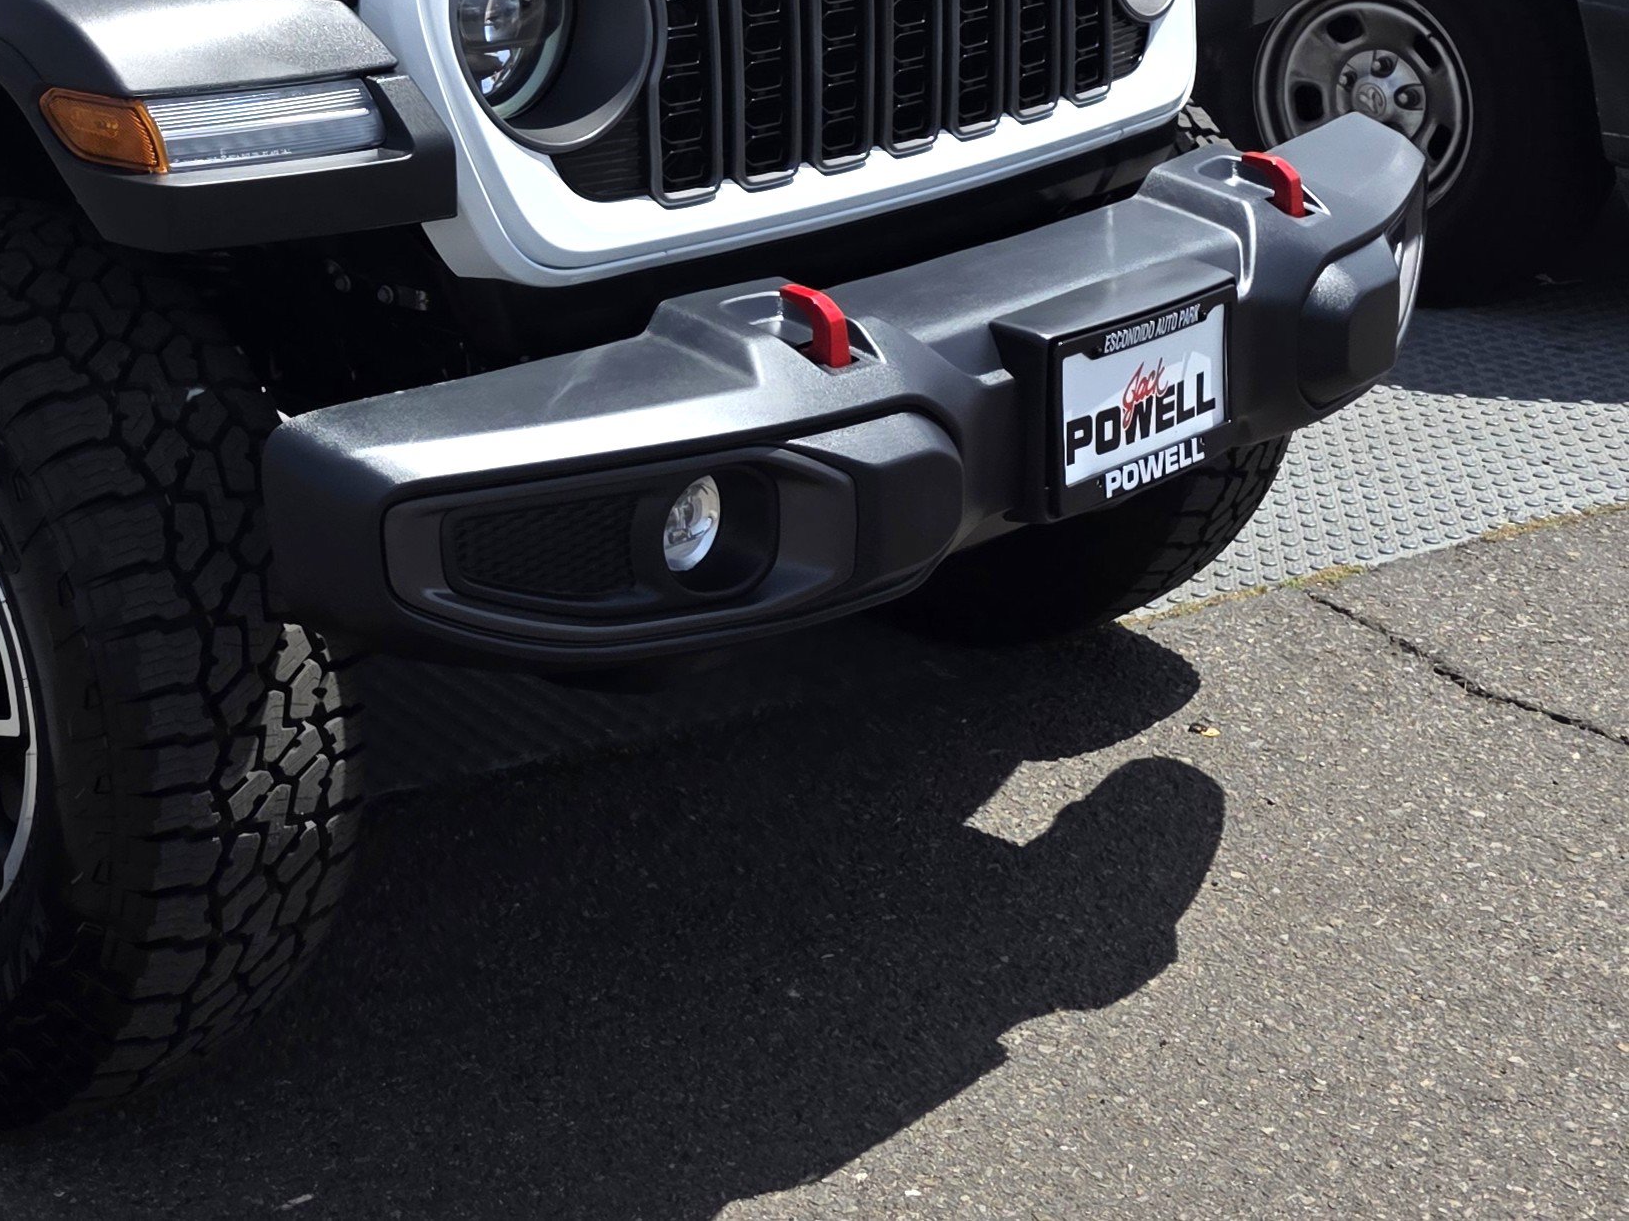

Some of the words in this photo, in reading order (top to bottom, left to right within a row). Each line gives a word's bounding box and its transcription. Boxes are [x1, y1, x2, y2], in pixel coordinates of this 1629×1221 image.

[1104, 320, 1155, 353] ESCONDIDO
[1155, 312, 1178, 337] AUTO
[1178, 303, 1201, 329] PARK
[1066, 371, 1216, 466] POWELL
[1122, 357, 1168, 429] Jack
[1105, 437, 1205, 498] POWELL
